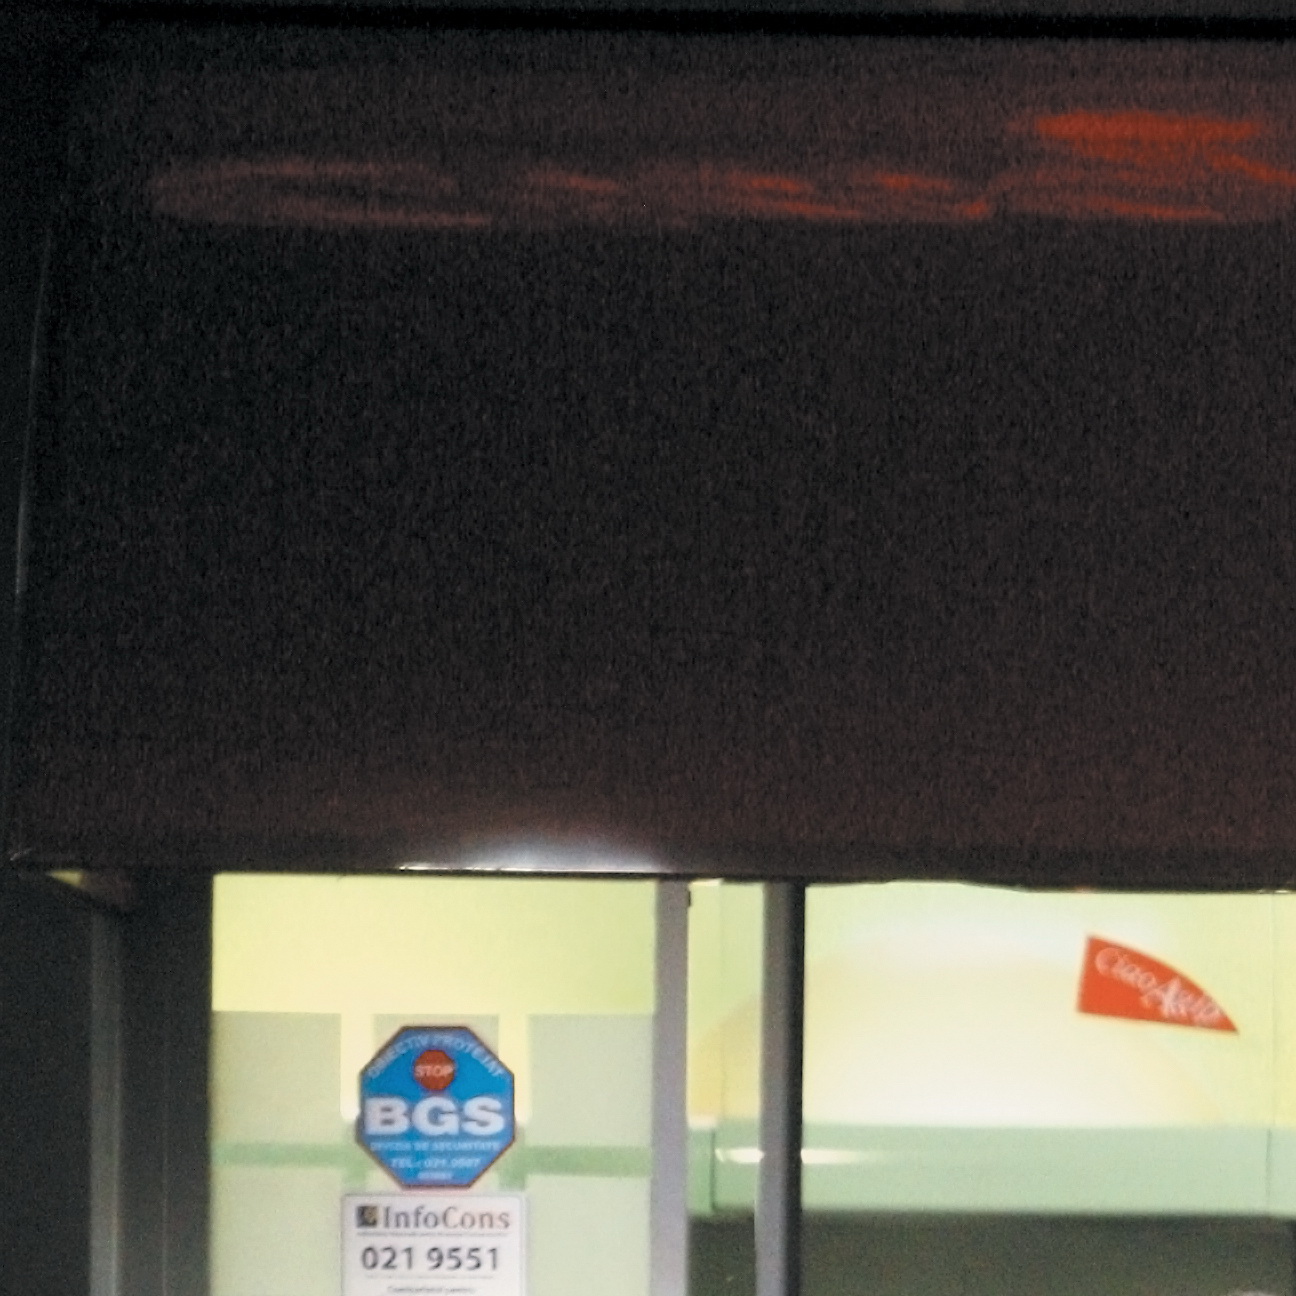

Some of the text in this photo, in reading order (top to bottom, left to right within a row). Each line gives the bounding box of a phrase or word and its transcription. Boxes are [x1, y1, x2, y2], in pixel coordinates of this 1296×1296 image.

[414, 1063, 455, 1078] STOP
[364, 1095, 506, 1136] BGS
[383, 1205, 511, 1230] InfoCons
[361, 1246, 499, 1271] 021 9551
